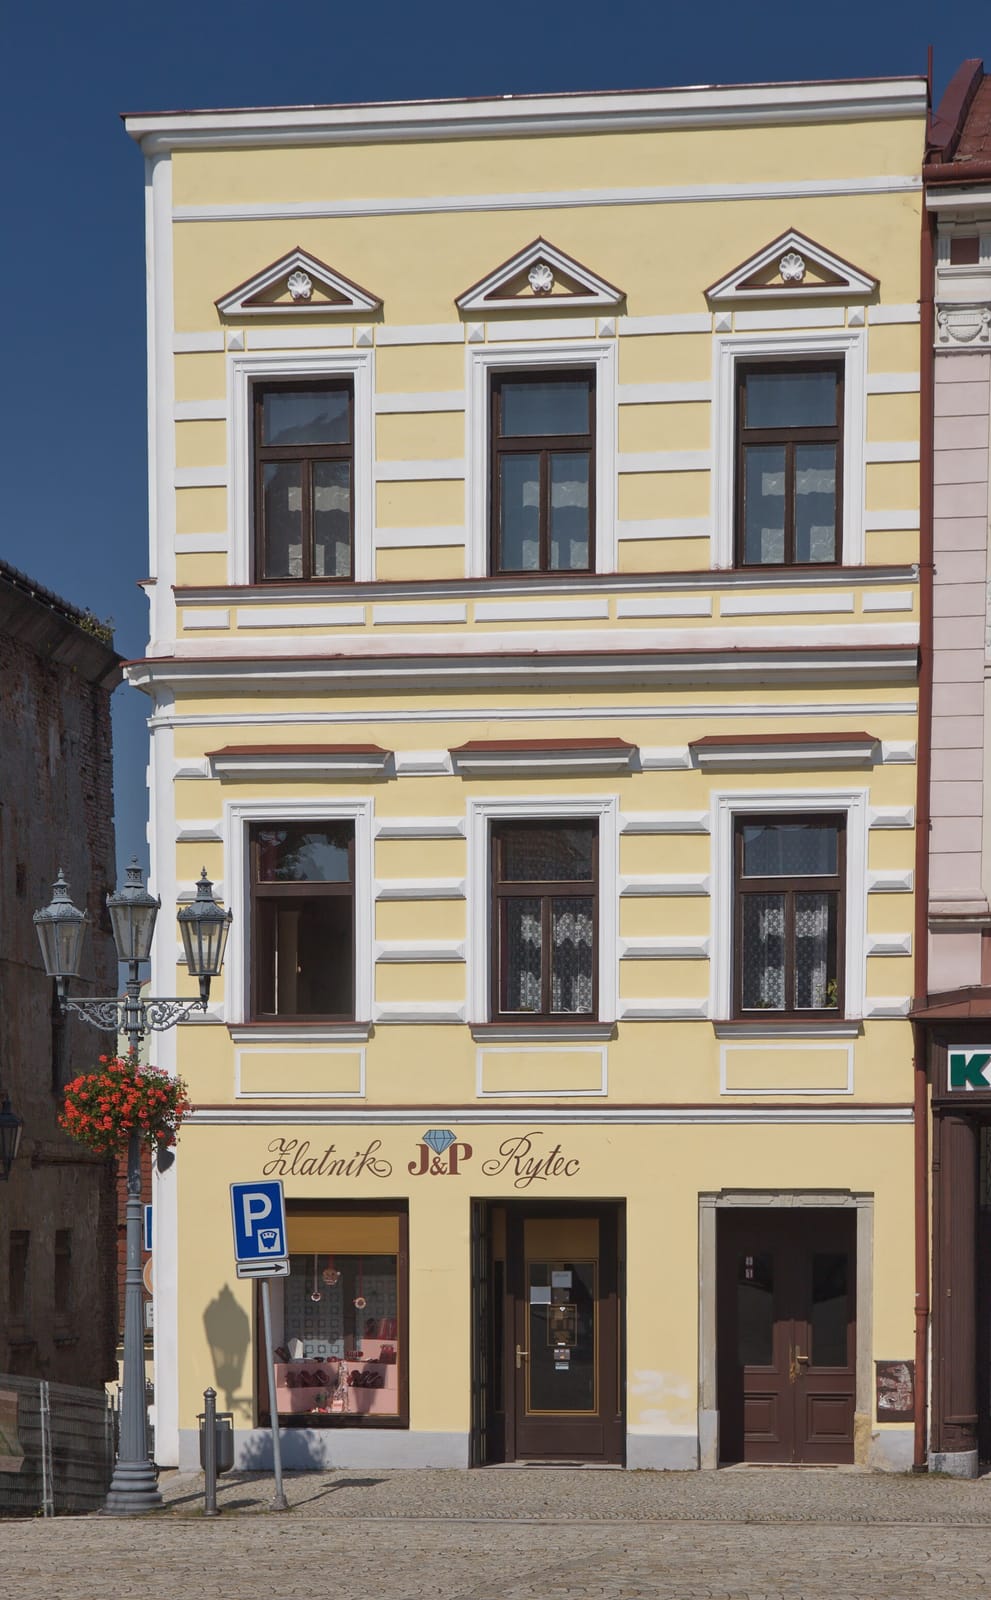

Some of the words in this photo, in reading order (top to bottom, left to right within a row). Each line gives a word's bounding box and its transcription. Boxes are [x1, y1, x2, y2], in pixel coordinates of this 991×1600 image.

[407, 1142, 473, 1176] J&P
[481, 1131, 581, 1189] Rytec
[242, 1192, 272, 1237] P
